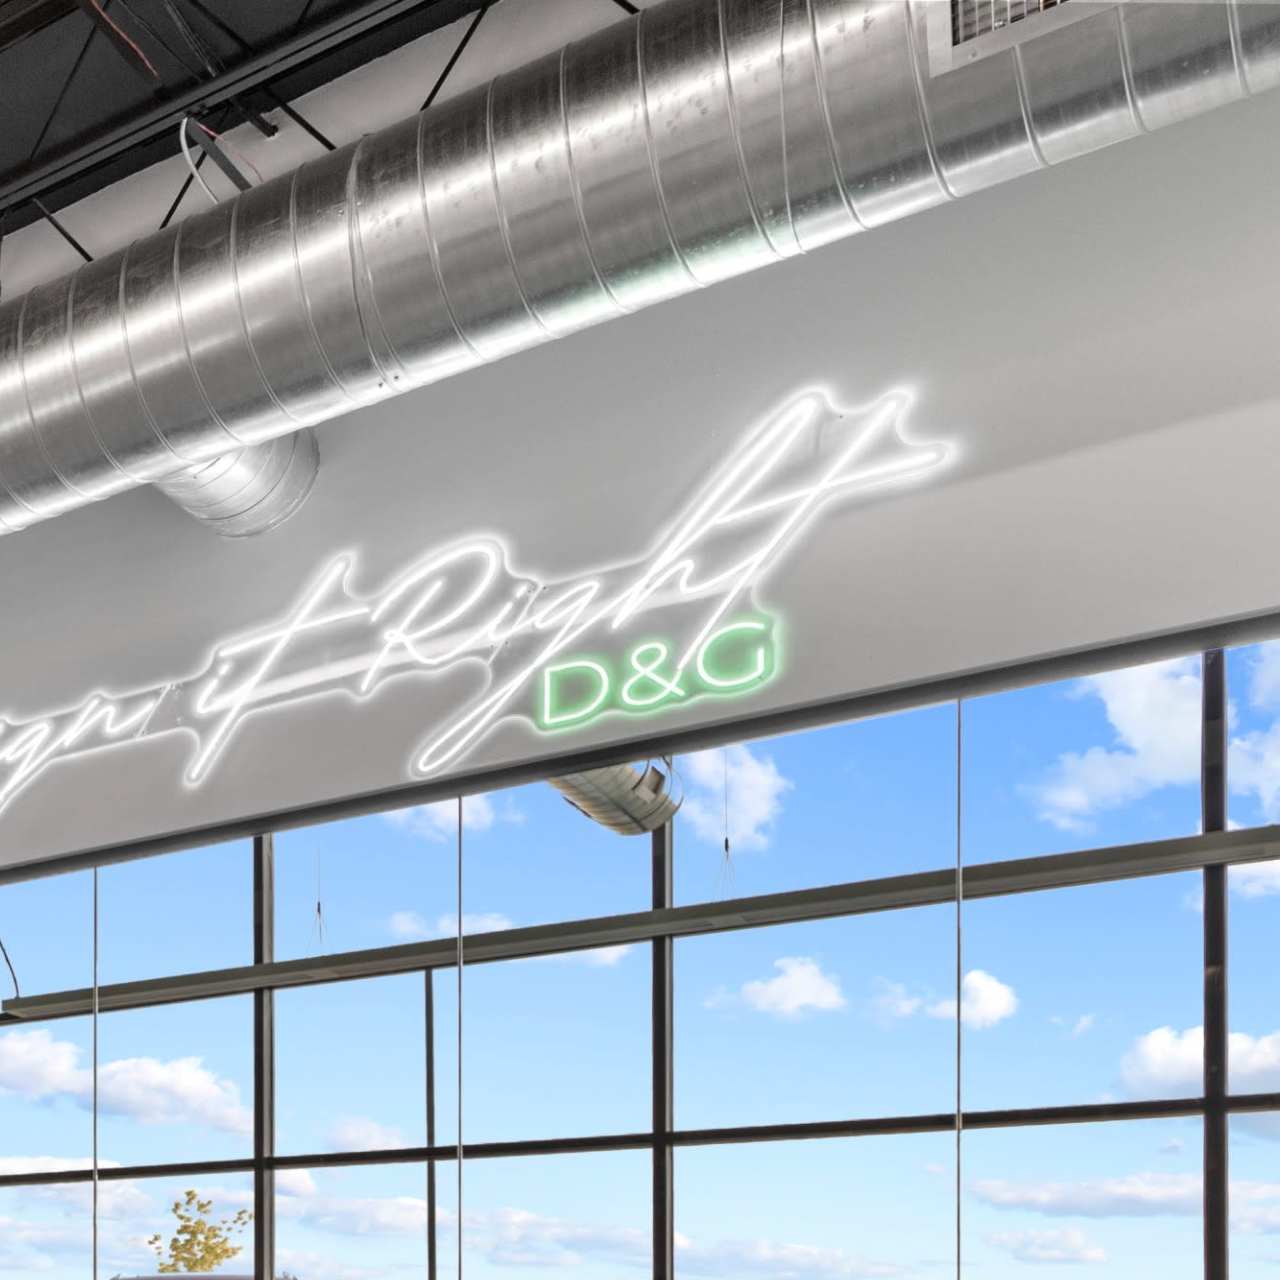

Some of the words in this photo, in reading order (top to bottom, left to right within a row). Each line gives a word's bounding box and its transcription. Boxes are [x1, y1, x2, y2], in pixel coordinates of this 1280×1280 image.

[188, 558, 371, 784] it
[359, 396, 944, 774] Right
[541, 619, 768, 726] D&G
